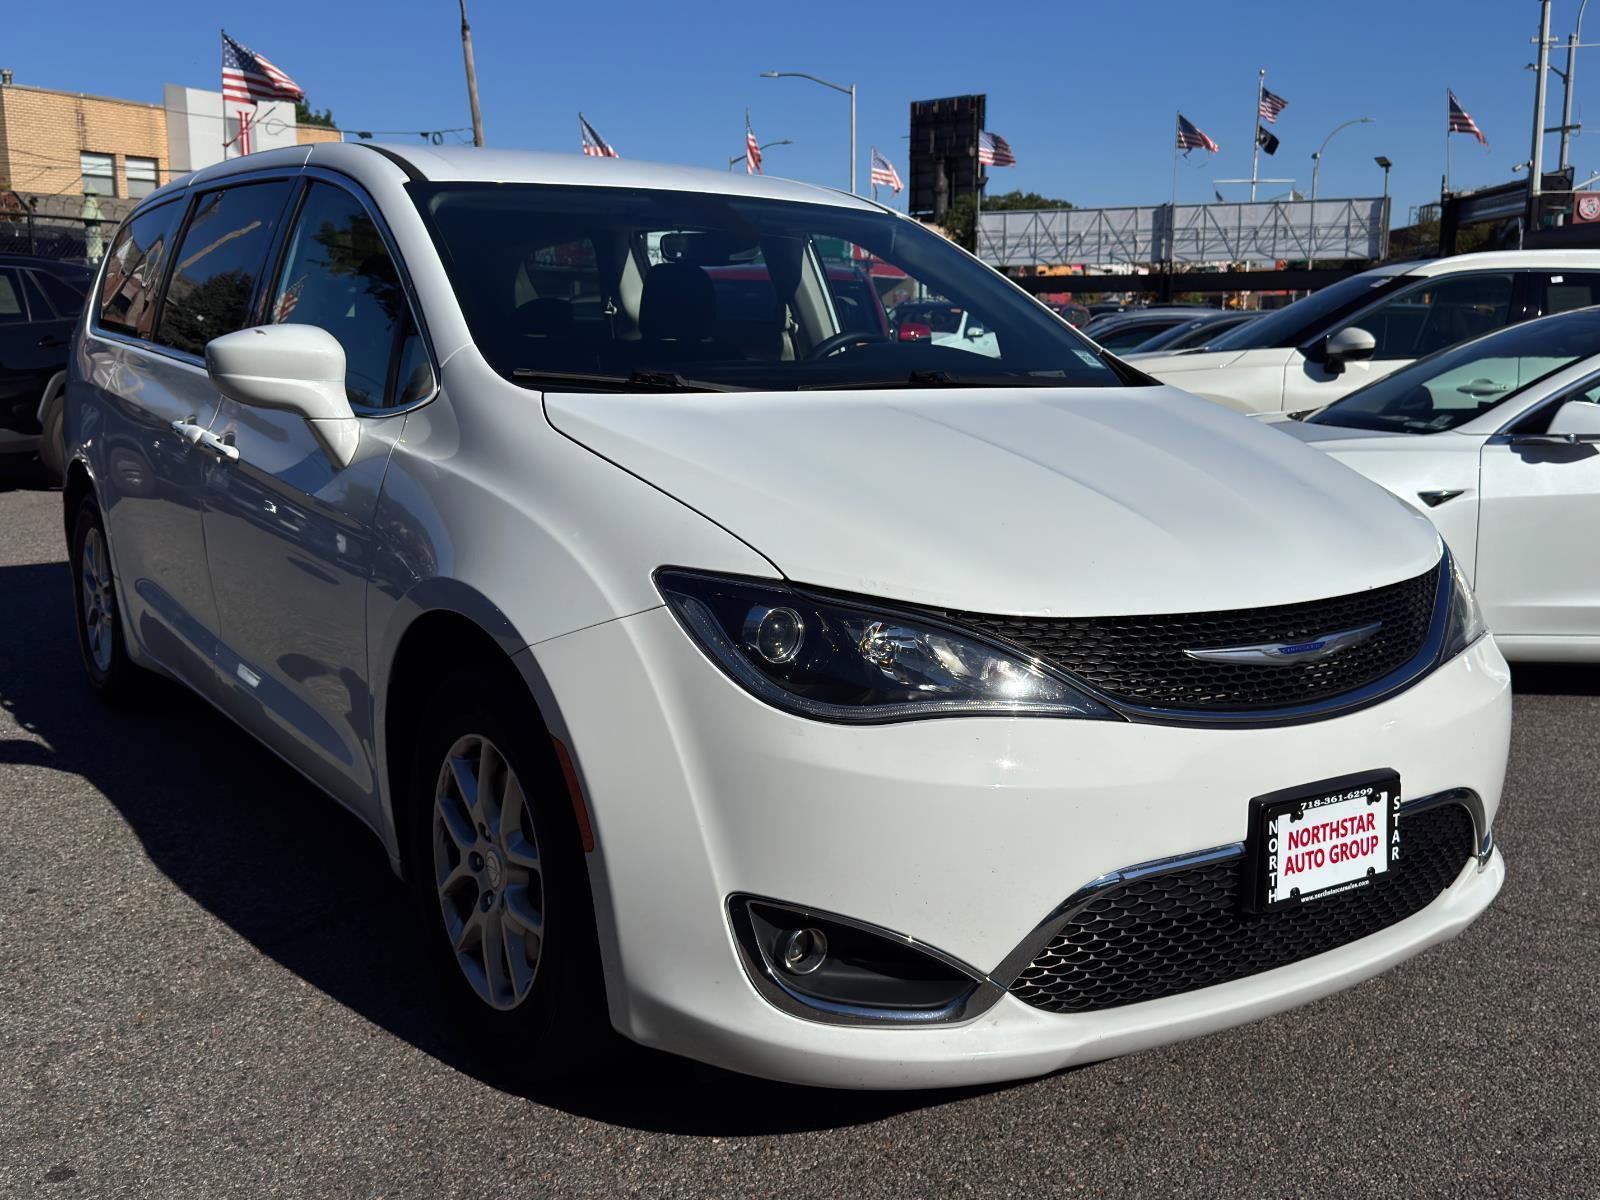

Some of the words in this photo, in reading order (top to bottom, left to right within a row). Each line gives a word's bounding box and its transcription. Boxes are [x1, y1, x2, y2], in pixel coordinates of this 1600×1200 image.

[1300, 787, 1373, 810] 718-361-6299
[1287, 812, 1376, 851] NORTHSTAR
[1391, 796, 1401, 861] STAR
[1268, 819, 1278, 904] NORTH
[1284, 848, 1325, 876] AUTO
[1329, 835, 1379, 864] GROUP
